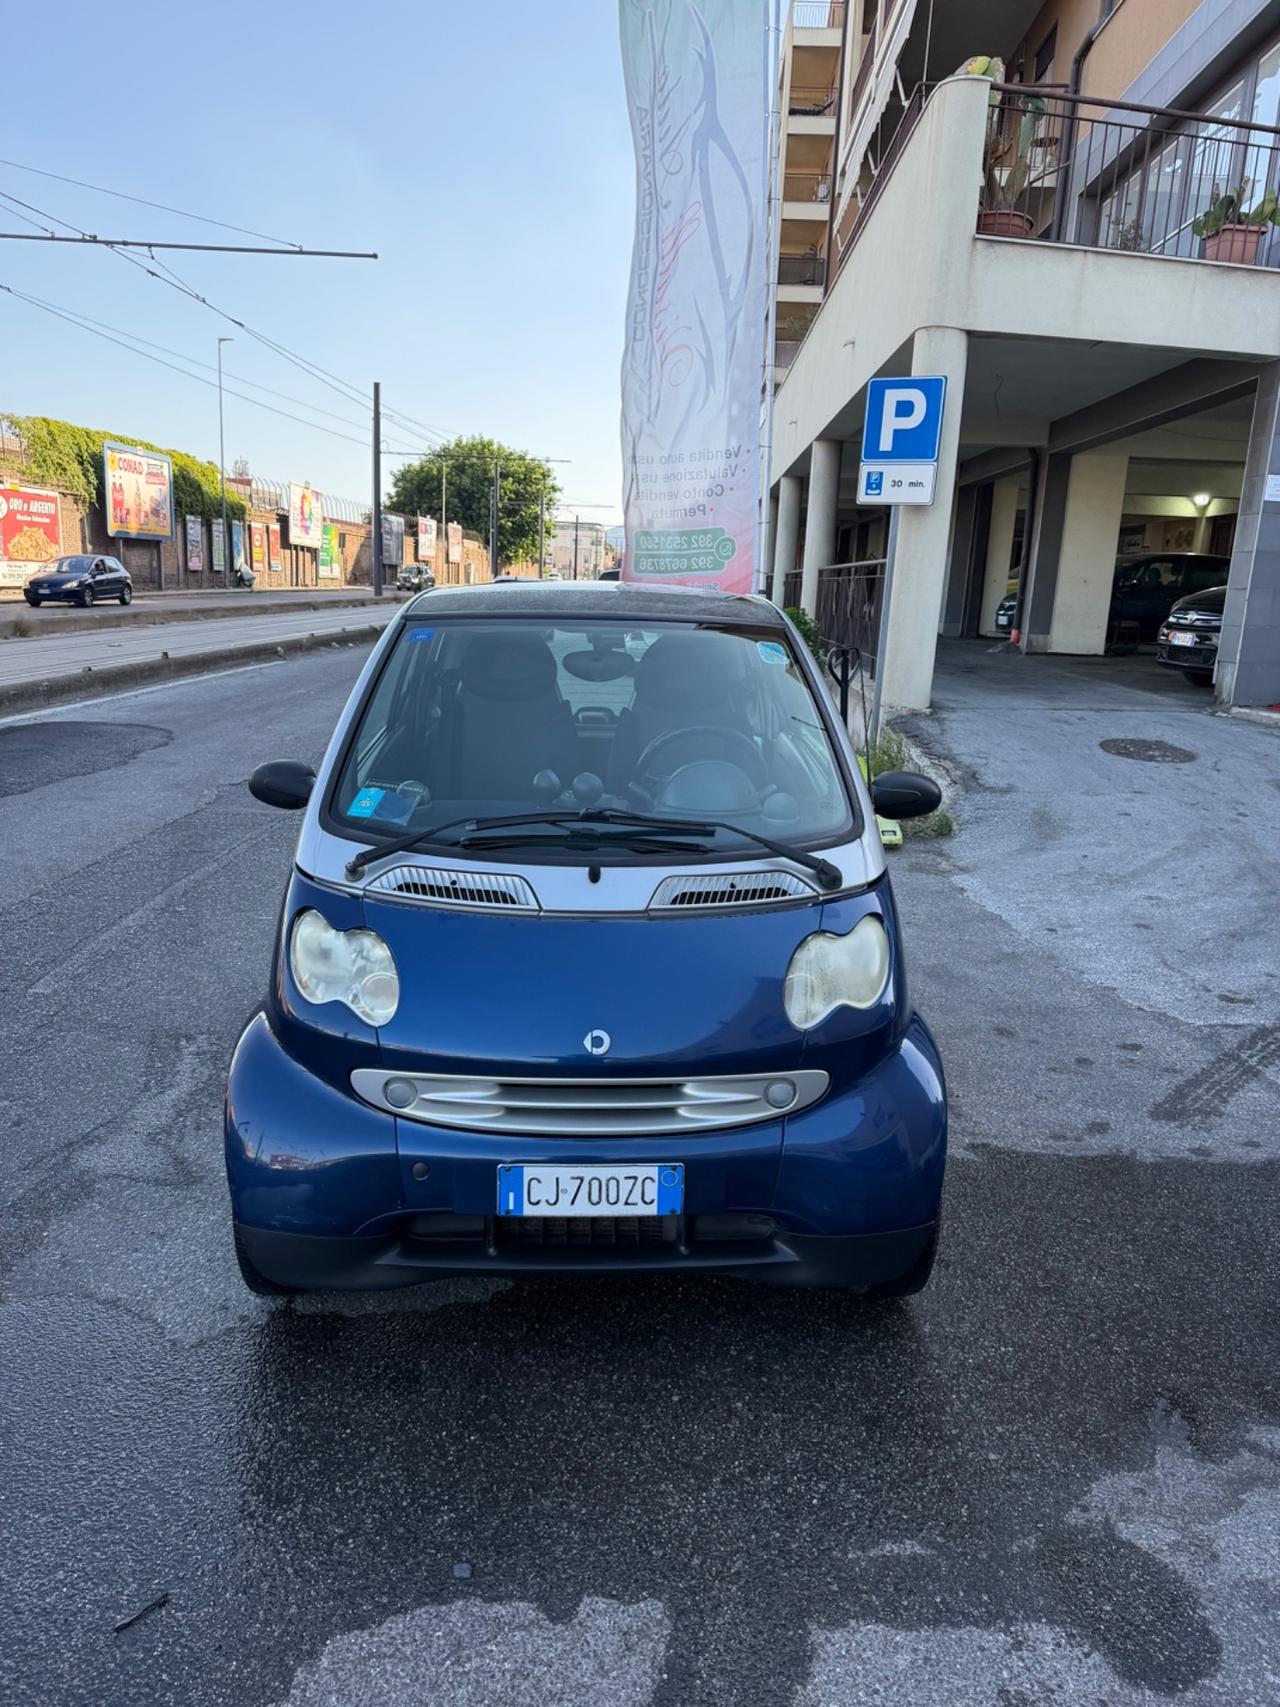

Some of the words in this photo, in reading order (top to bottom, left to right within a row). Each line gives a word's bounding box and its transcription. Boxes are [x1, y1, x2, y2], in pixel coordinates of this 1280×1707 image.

[879, 388, 927, 452] P
[117, 457, 144, 475] CONAD
[890, 479, 903, 488] 30
[908, 479, 926, 488] min.
